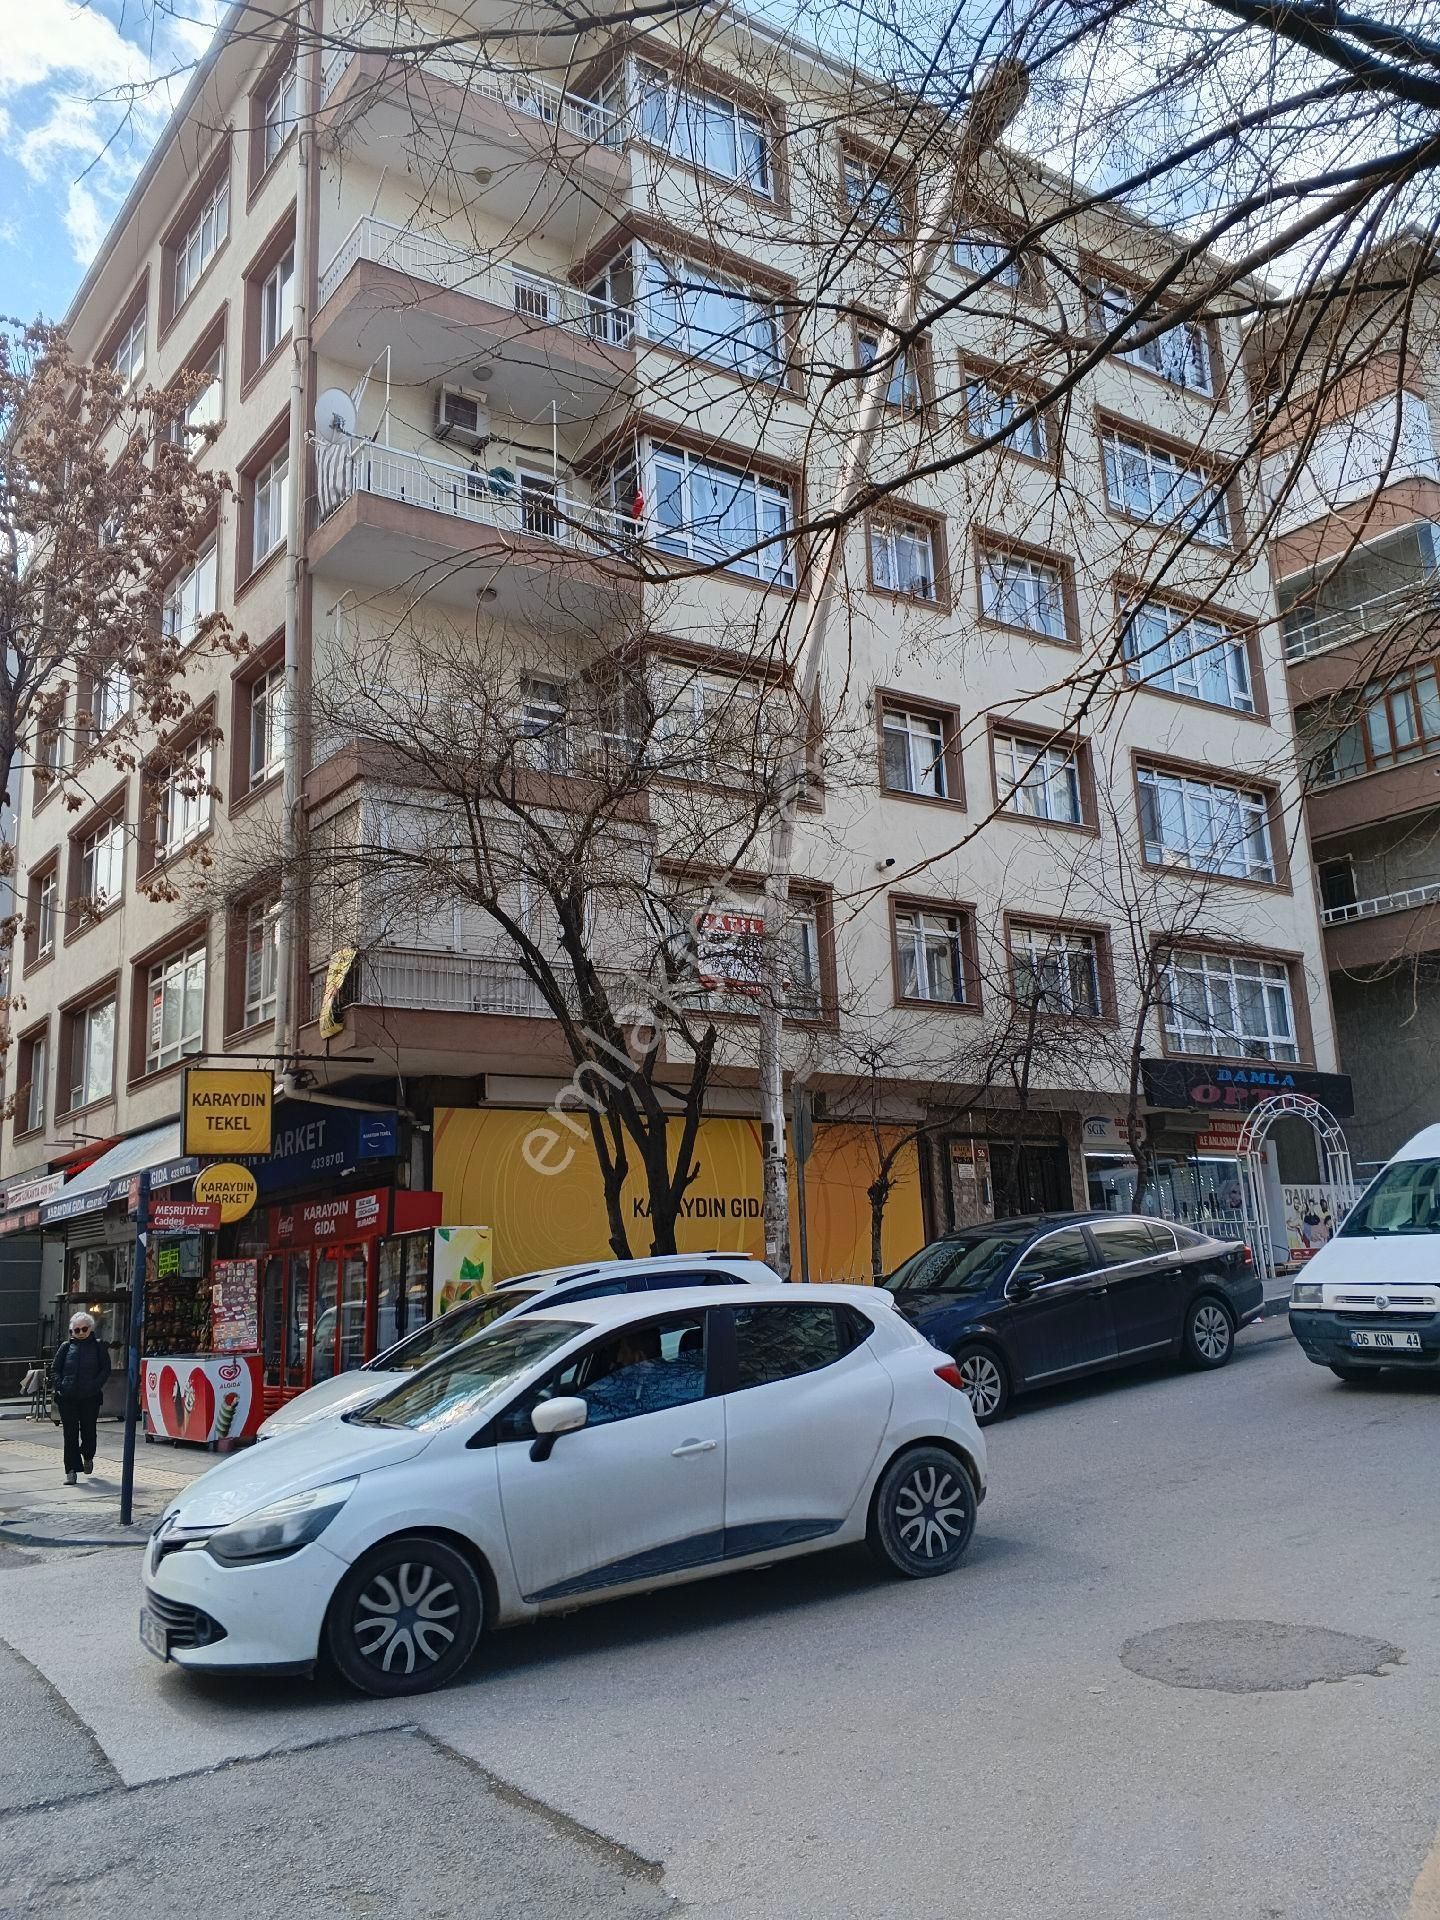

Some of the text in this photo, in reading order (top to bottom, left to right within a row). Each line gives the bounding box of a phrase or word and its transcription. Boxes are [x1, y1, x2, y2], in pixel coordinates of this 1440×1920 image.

[1216, 1068, 1296, 1087] DAMLA
[192, 1092, 266, 1107] KARAYDIN
[205, 1116, 252, 1130] TEKEL
[1087, 1123, 1106, 1135] SGK
[311, 1152, 345, 1170] 433 87 01
[151, 1167, 168, 1185] GIDA
[201, 1182, 255, 1192] KARAYDIN
[205, 1193, 250, 1204] MARKET
[155, 1204, 210, 1217] MEŞRUTİYET
[304, 1200, 349, 1220] KARAYDIN
[633, 1197, 726, 1218] KYDIN
[154, 1216, 185, 1227] Caddesi
[314, 1220, 336, 1235] GIDA
[1356, 1333, 1419, 1346] 06 KON 44
